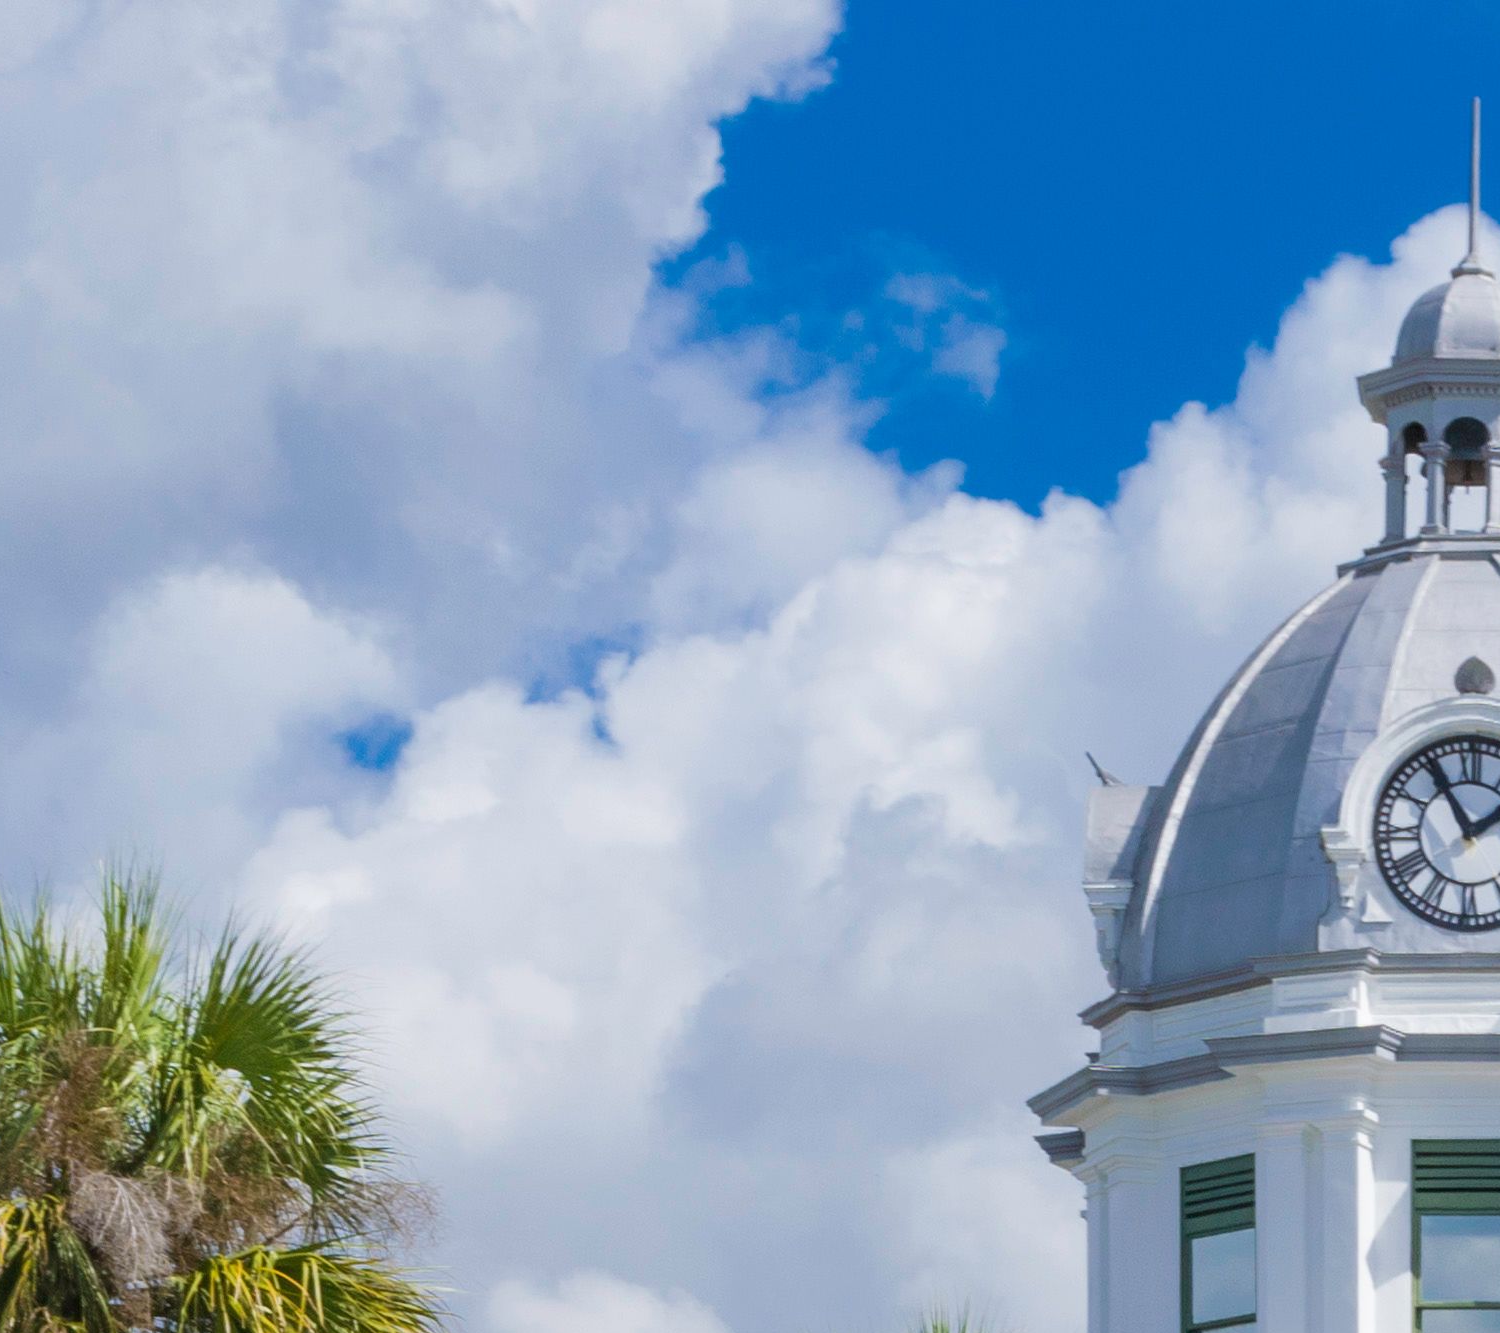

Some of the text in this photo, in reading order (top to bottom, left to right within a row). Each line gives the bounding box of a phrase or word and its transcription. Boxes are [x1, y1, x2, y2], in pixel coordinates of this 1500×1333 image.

[1460, 751, 1483, 784] XII
[1397, 789, 1429, 812] X
[1388, 823, 1419, 841] IX
[1394, 849, 1430, 884] VIII
[1421, 875, 1448, 909] VII
[1461, 886, 1478, 915] VI
